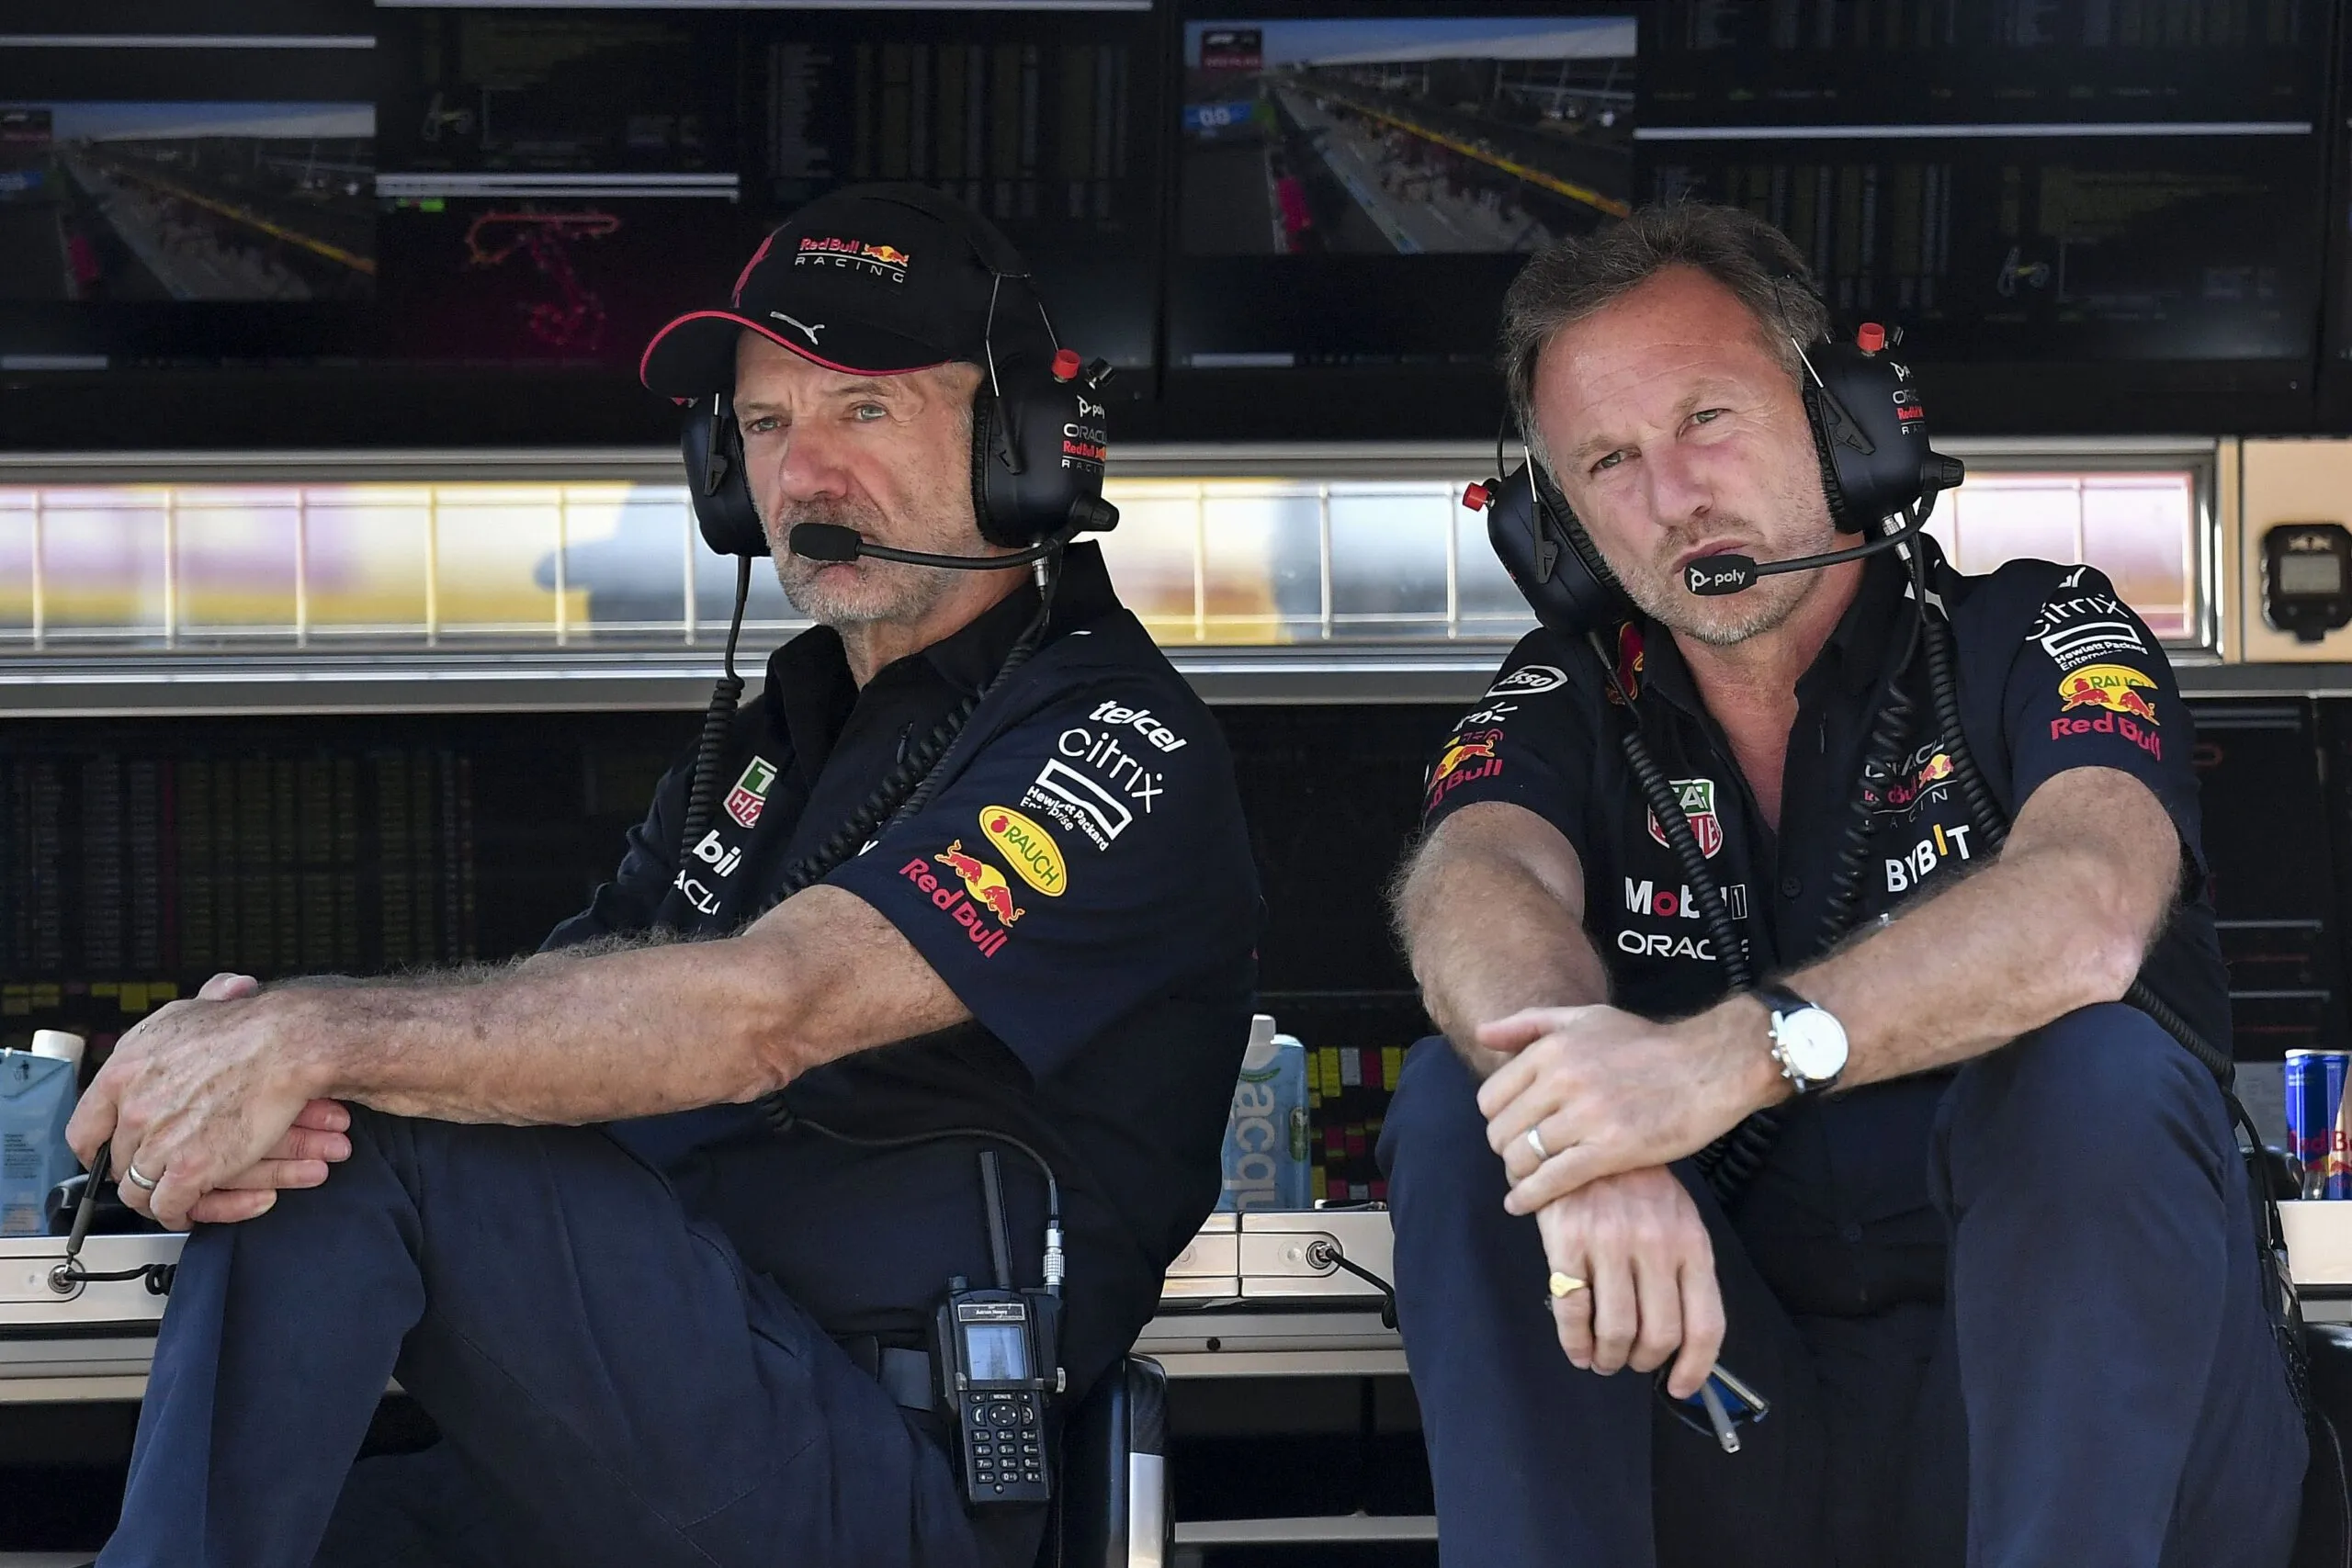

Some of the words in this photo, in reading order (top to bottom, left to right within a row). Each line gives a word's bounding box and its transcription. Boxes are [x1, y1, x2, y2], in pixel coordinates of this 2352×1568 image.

[799, 238, 830, 252] Red
[831, 240, 861, 254] Bull
[795, 256, 906, 284] RACING
[1063, 423, 1107, 445] ORACL
[1714, 569, 1746, 587] poly
[2054, 642, 2105, 663] Hewlett
[2059, 649, 2122, 671] Enter
[2090, 675, 2144, 689] RAU
[1088, 700, 1187, 753] telcel
[2051, 711, 2115, 740] Red
[2118, 716, 2162, 761] Bull
[1058, 728, 1164, 814] Citrix
[1446, 759, 1504, 791] Bull
[1019, 795, 1075, 831] Enprise
[1072, 808, 1110, 852] Packard
[692, 829, 742, 878] bil
[1003, 825, 1059, 887] RAUCH
[1884, 823, 1971, 893] BYBIT
[899, 858, 965, 911] Red
[952, 900, 1009, 959] Bull
[1625, 876, 1727, 919] Mob
[1617, 930, 1749, 961] ORAC
